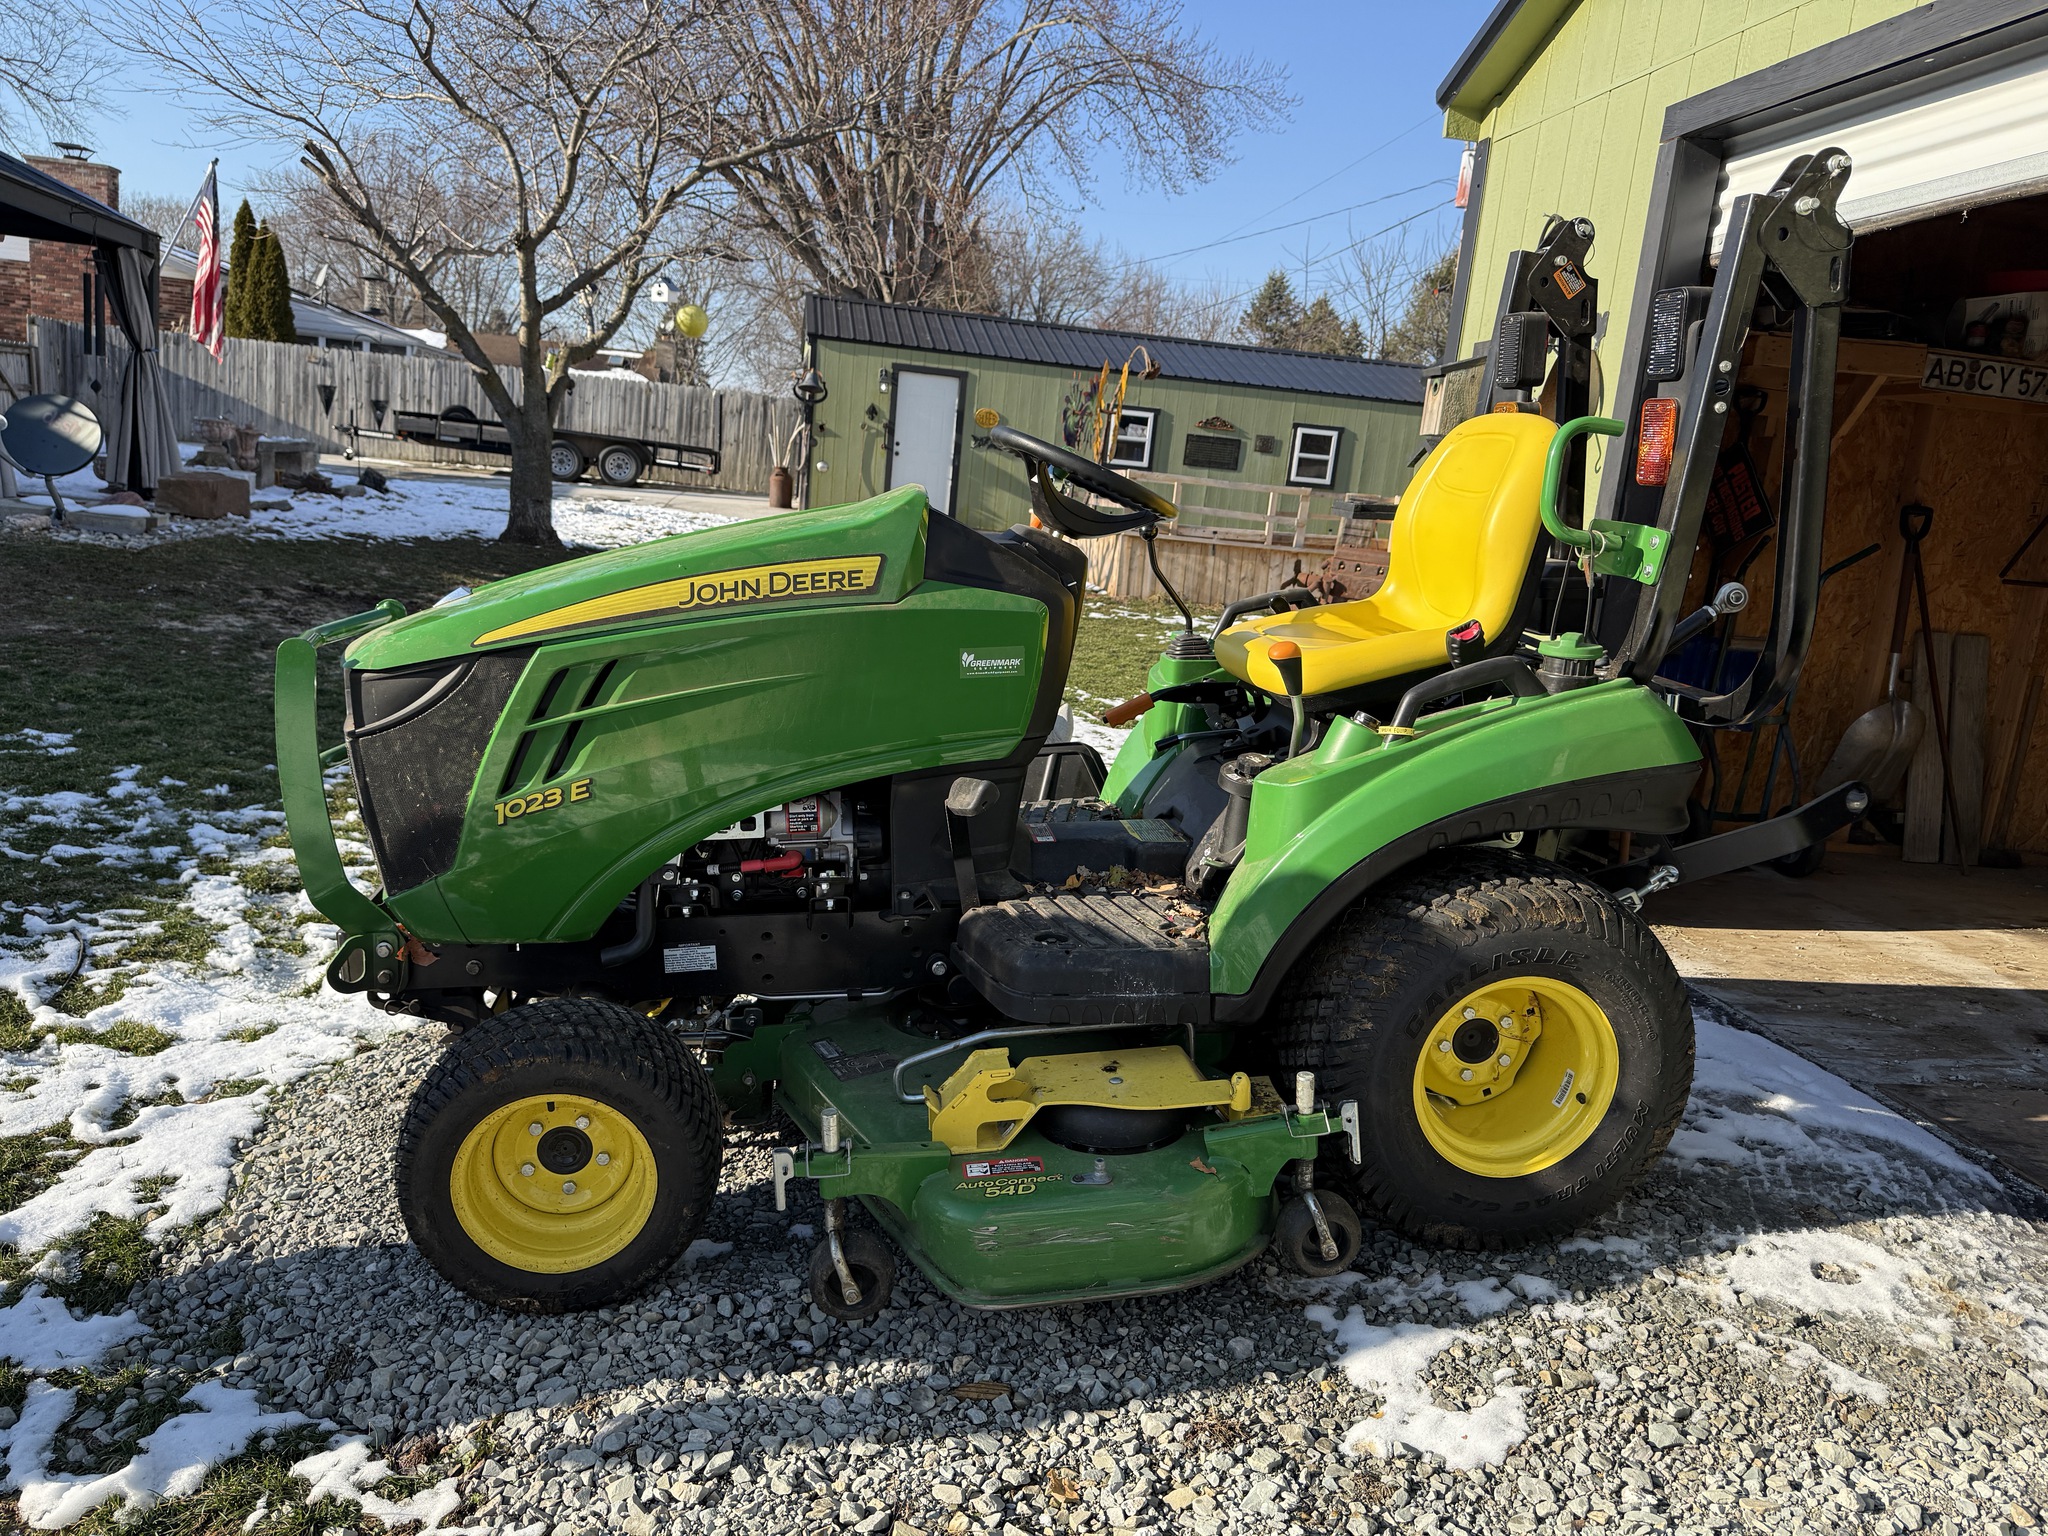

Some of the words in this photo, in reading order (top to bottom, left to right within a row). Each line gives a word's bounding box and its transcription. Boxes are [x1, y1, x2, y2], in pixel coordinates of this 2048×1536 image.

[2017, 367, 2048, 398] 57
[1727, 461, 1762, 521] POSTED
[1711, 512, 1727, 537] OUT
[678, 577, 761, 607] JOHN
[768, 569, 864, 595] DEERE
[970, 658, 1021, 667] GREENMARK
[494, 787, 564, 826] 1023
[570, 778, 592, 802] E
[1404, 946, 1586, 1040] CARLISLE
[1595, 1099, 1650, 1179] MULTI
[955, 1172, 1065, 1191] AutoConnect
[984, 1183, 1037, 1199] 54D
